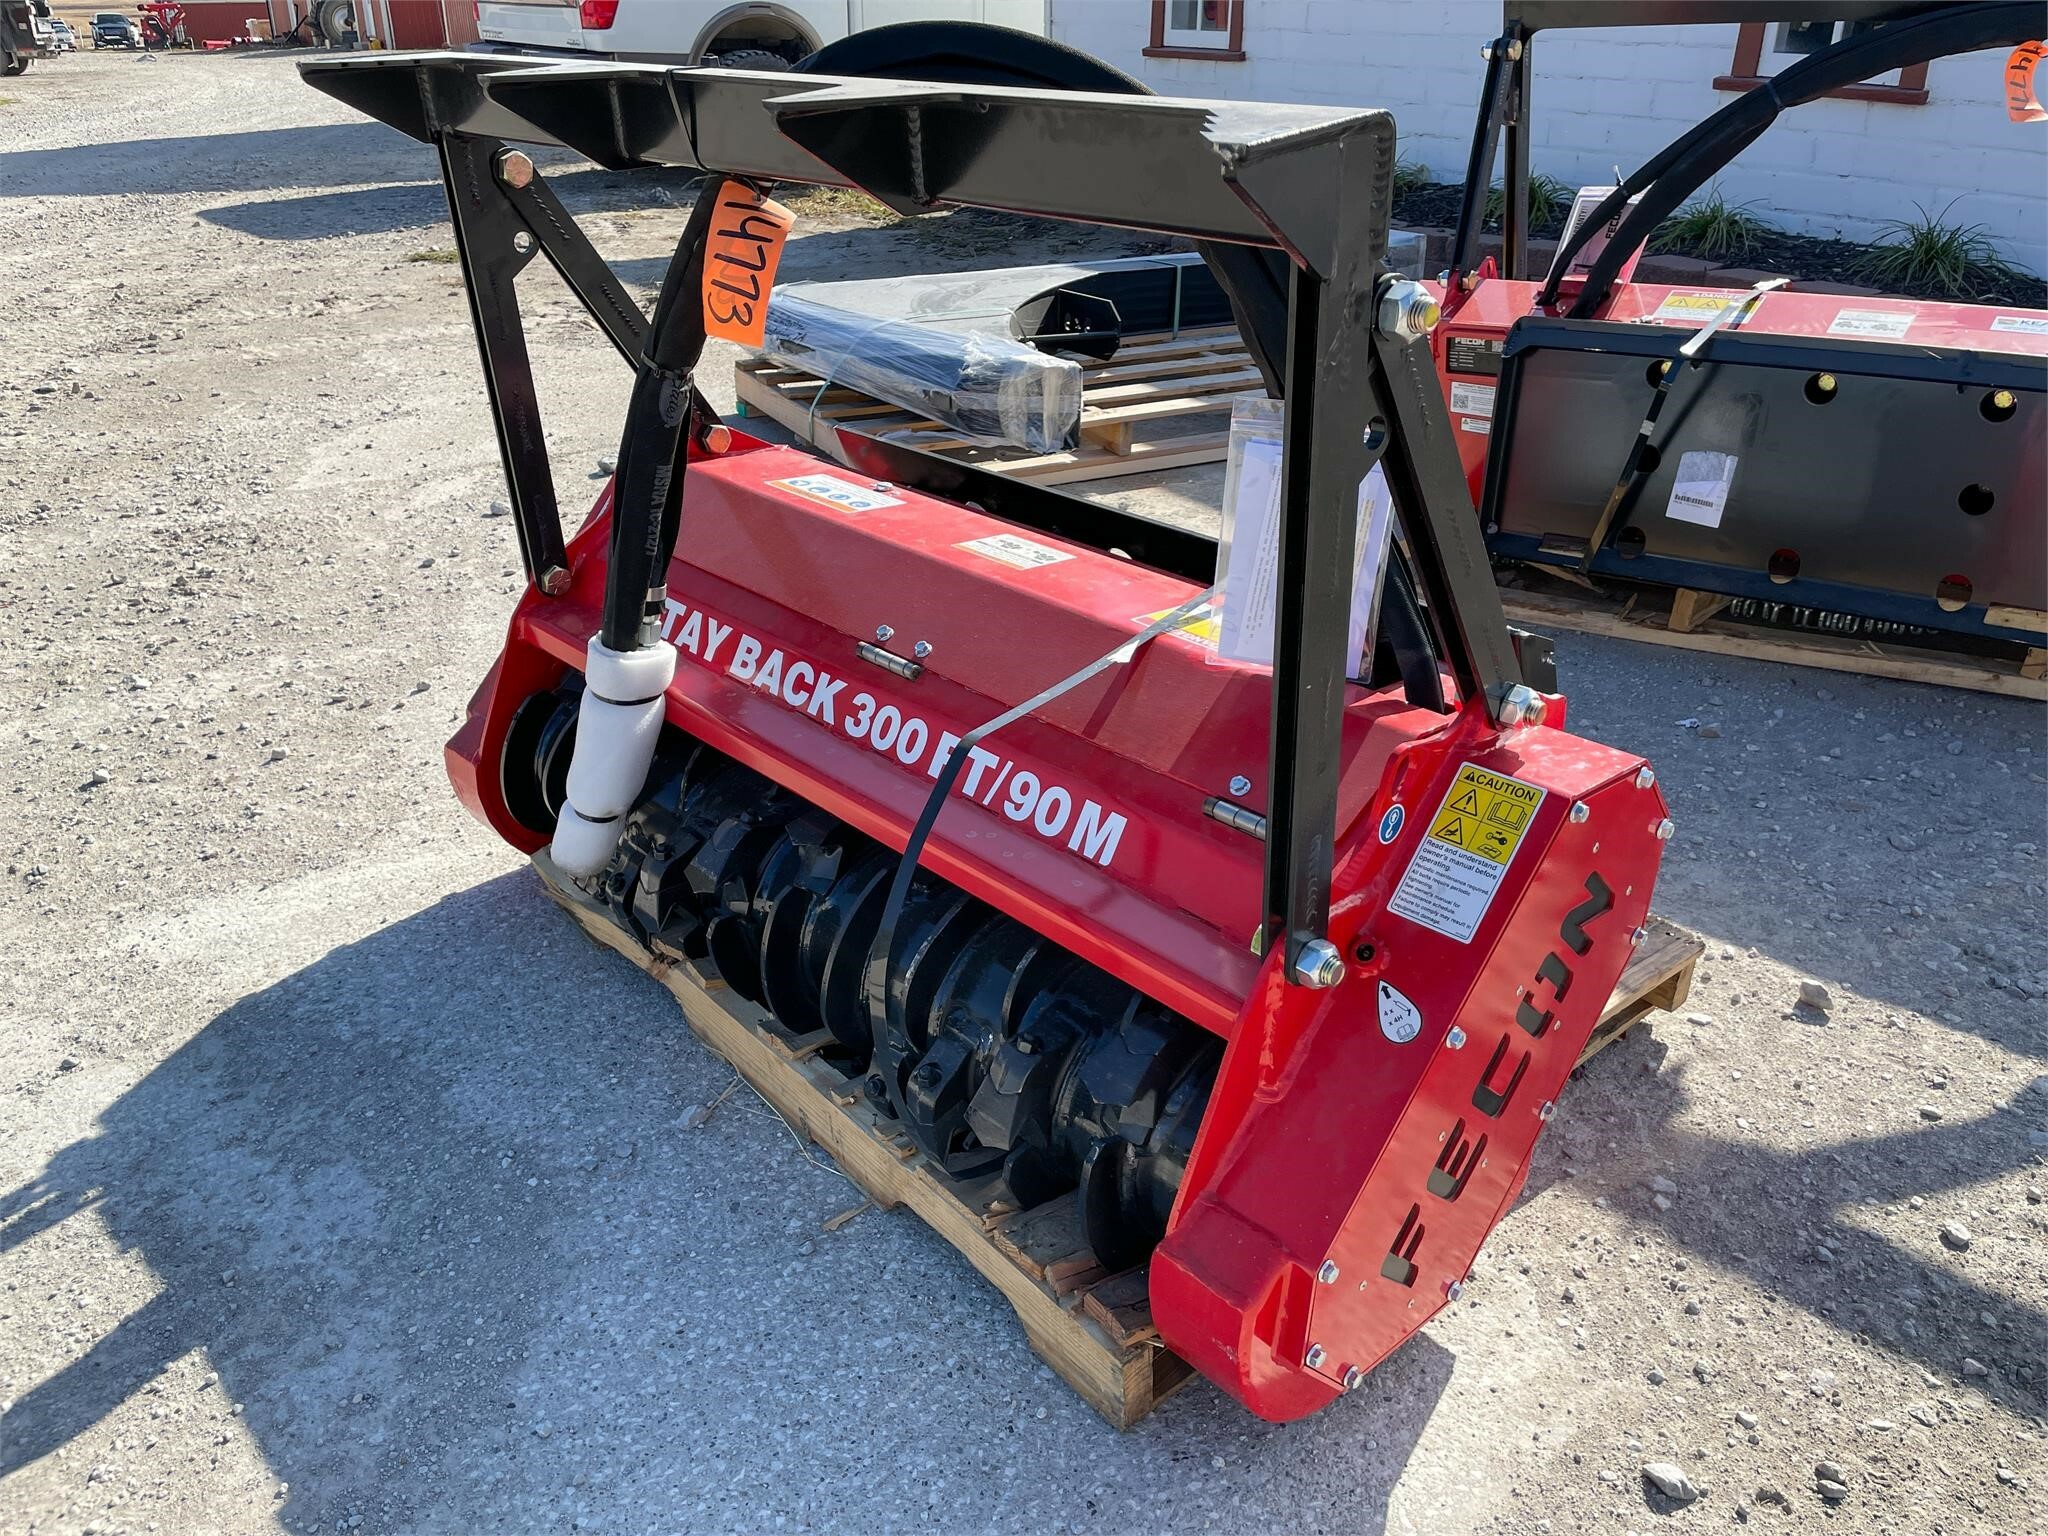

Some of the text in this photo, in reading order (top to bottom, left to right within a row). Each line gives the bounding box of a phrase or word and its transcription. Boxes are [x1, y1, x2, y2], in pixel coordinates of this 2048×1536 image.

[708, 201, 787, 327] 14773
[1454, 337, 1486, 346] FECON
[660, 597, 1128, 867] TAY BACK 300 FT/90 M
[1476, 774, 1536, 802] CAUTION
[1422, 847, 1498, 880] owner's manual before
[1426, 839, 1498, 871] Read and understand
[1411, 868, 1471, 896] All bolts require periodic
[1415, 861, 1434, 873] Periodic
[1436, 871, 1466, 886] maintenance
[1434, 894, 1453, 905] manual
[1440, 912, 1450, 921] may
[1451, 917, 1466, 927] result
[1381, 870, 1615, 1288] FECON
